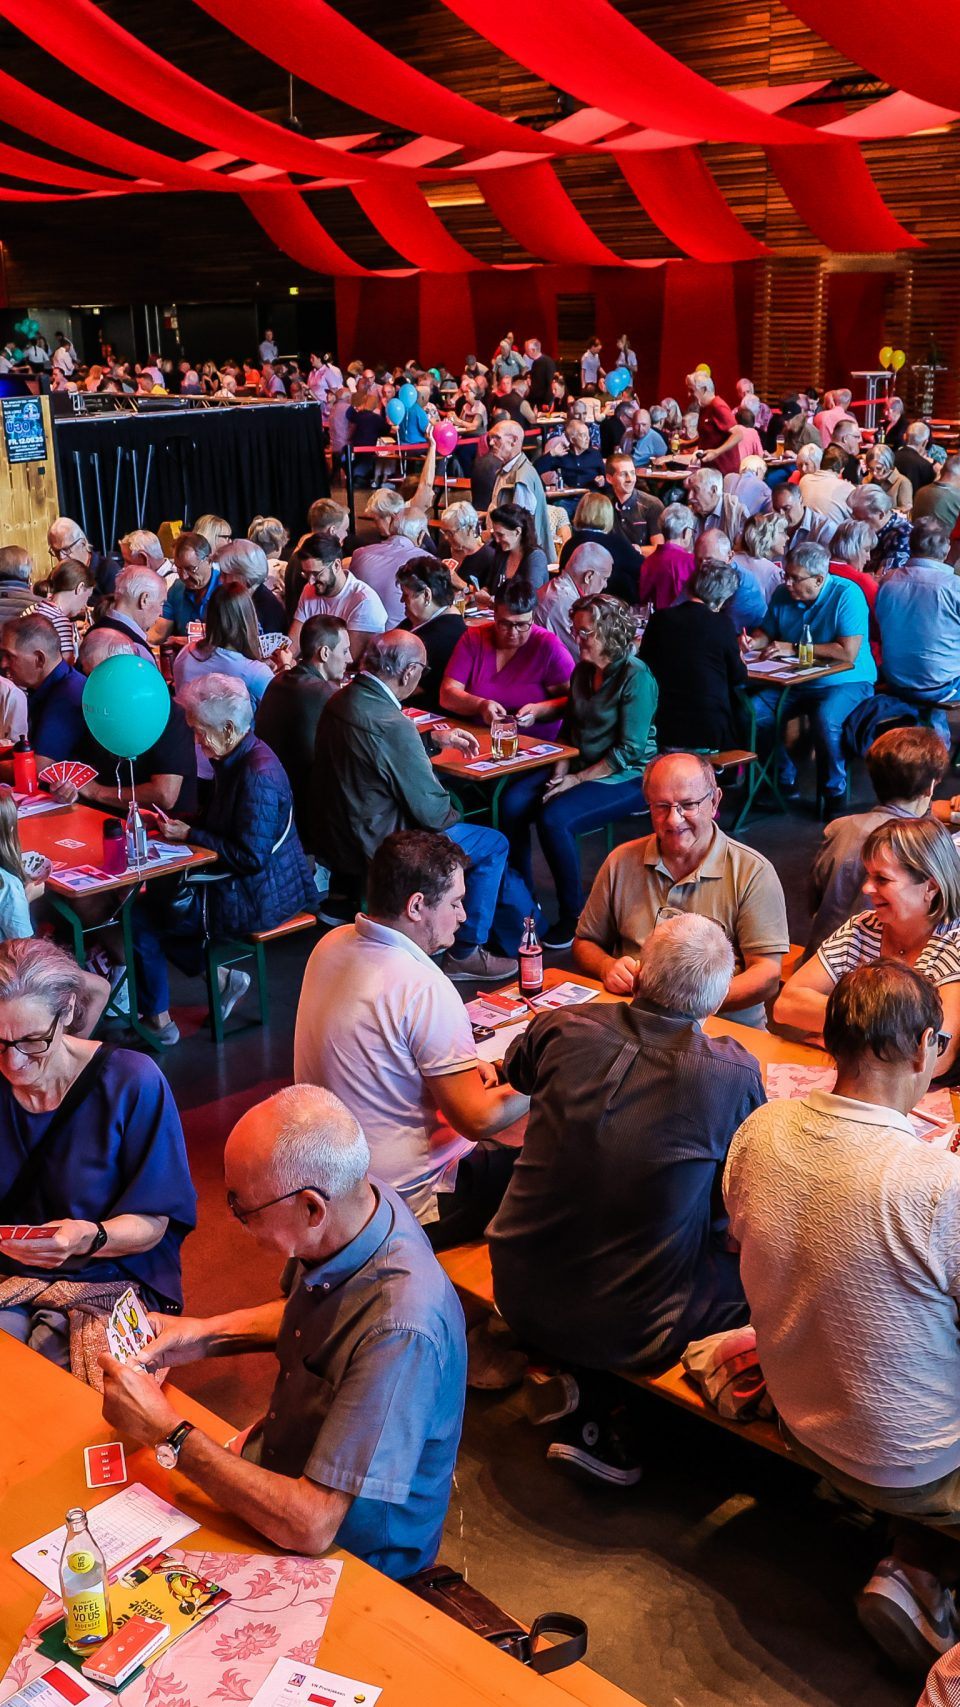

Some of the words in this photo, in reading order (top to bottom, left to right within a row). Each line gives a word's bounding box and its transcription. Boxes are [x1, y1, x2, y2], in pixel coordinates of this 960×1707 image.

[72, 1601, 99, 1613] APFEL
[141, 1599, 164, 1615] MESSE
[72, 1612, 86, 1622] VO
